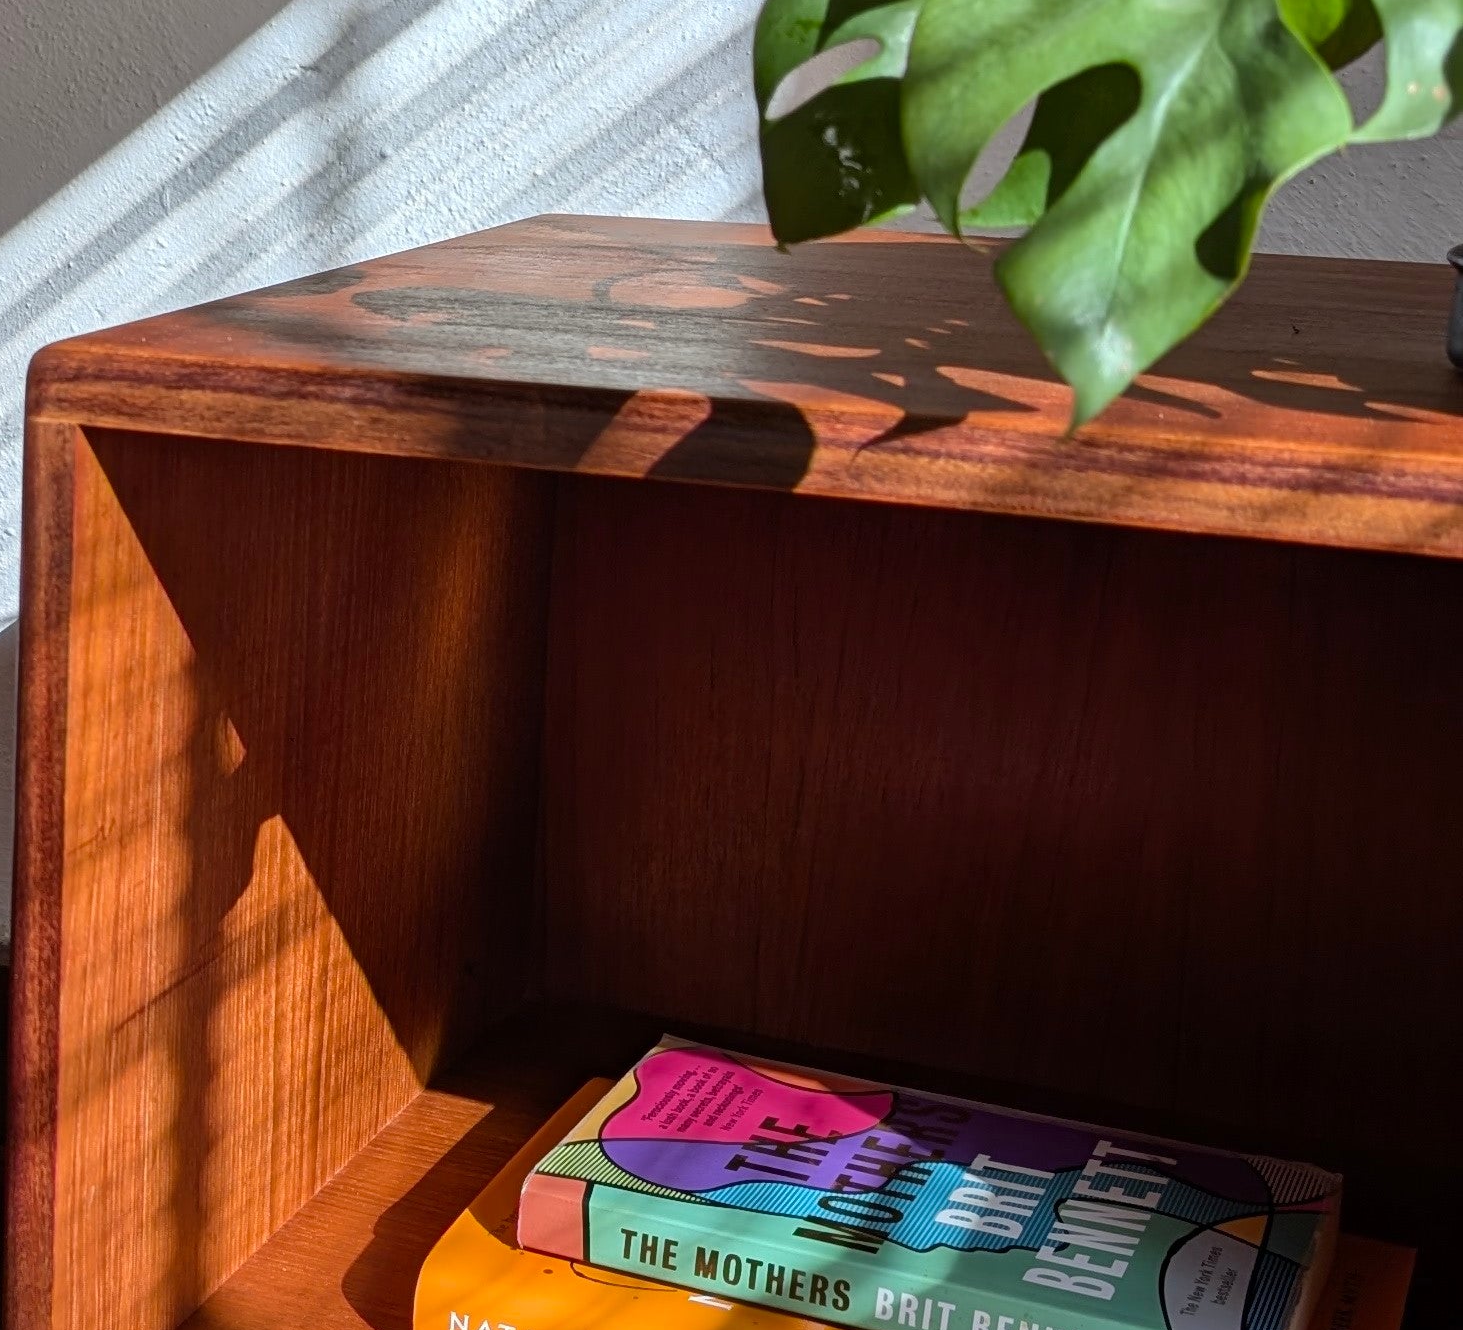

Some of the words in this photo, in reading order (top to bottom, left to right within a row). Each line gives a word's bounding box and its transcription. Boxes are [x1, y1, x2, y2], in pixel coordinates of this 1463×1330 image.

[724, 1116, 844, 1182] THE
[792, 1094, 972, 1255] MOTHERS
[933, 1153, 1056, 1239] BRIT
[1022, 1139, 1178, 1301] BENNETT
[621, 1227, 679, 1271] THE
[694, 1246, 851, 1311] MOTHERS
[1194, 1270, 1214, 1290] York
[1201, 1246, 1224, 1271] Times
[1179, 1302, 1199, 1316] The
[1187, 1286, 1204, 1304] New
